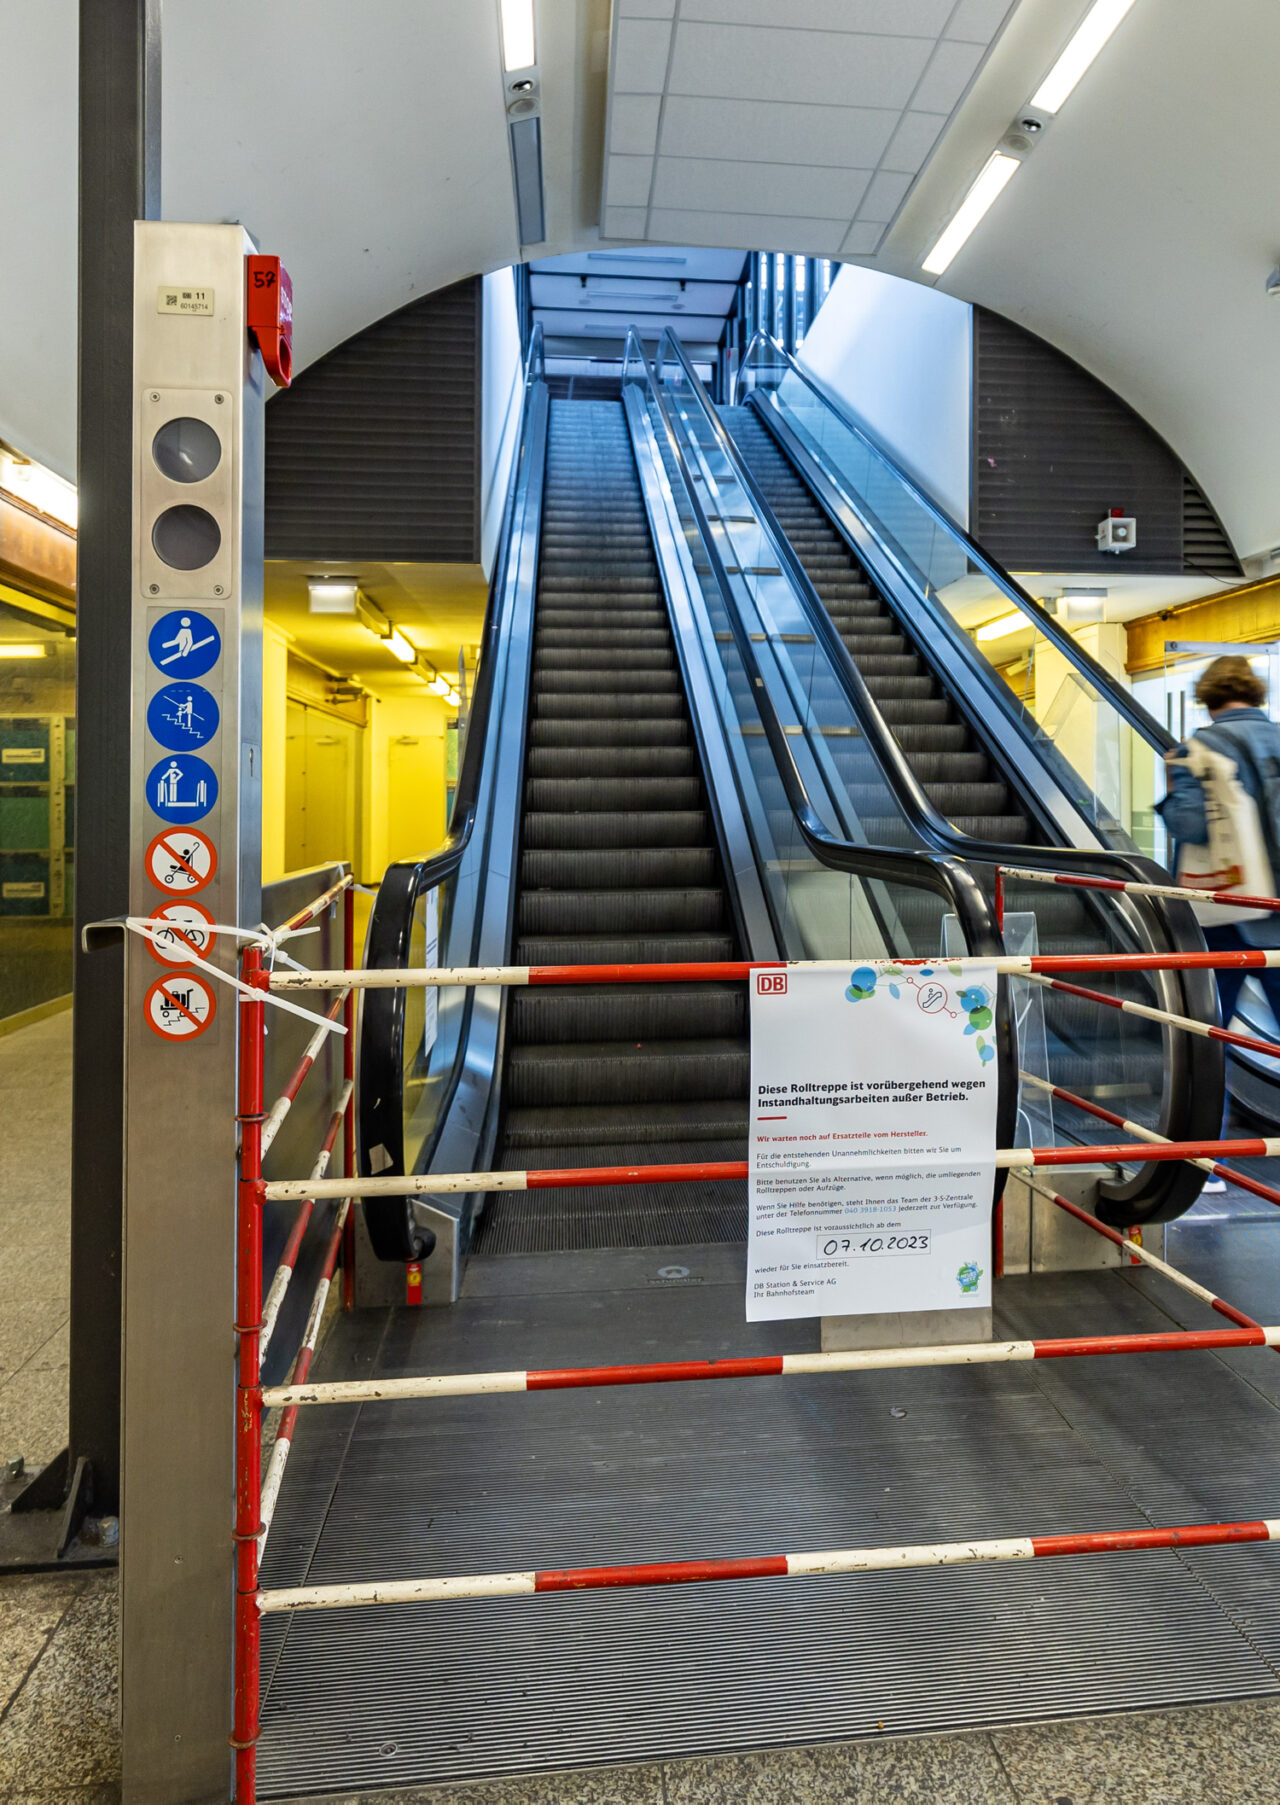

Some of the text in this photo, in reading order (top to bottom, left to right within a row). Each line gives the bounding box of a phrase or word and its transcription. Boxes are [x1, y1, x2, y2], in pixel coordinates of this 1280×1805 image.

[253, 271, 276, 289] 57
[759, 975, 785, 993] DB
[758, 1079, 986, 1095] Diese Rolltreppe ist vorübergehend wegen
[757, 1092, 969, 1108] Instandhaltungsarbeiten außer Betrieb.
[756, 1135, 770, 1143] Wir
[832, 1132, 872, 1140] Ersatzteile
[890, 1130, 929, 1138] Hersteller.
[770, 1152, 782, 1160] die
[782, 1151, 830, 1159] entstehenden
[831, 1147, 902, 1157] Unannehmlichkeiten
[903, 1147, 925, 1155] bitten
[756, 1160, 812, 1169] Entschuldigung.
[756, 1178, 774, 1186] Bitte
[775, 1177, 808, 1185] benutzen
[809, 1176, 820, 1184] Sie
[821, 1176, 832, 1184] als
[833, 1175, 874, 1183] Alternative,
[895, 1172, 925, 1181] möglich,
[925, 1171, 937, 1179] die
[938, 1170, 982, 1179] umliegenden
[756, 1183, 846, 1194] Rolltreppen oder Aufzüge.
[776, 1202, 788, 1210] Sie
[807, 1200, 845, 1208] benötigen,
[846, 1198, 864, 1206] steht
[900, 1196, 919, 1204] Team
[756, 1212, 774, 1220] unter
[789, 1209, 843, 1217] Telefonnummer
[898, 1204, 928, 1213] jederzeit
[942, 1201, 978, 1210] Verfügung.
[756, 1229, 775, 1237] Diese
[776, 1226, 812, 1234] Rolltreppe
[813, 1224, 822, 1232] ist
[823, 1222, 875, 1231] voraussichtlich
[823, 1235, 929, 1256] 07.10.2023
[754, 1266, 778, 1274] wieder
[803, 1261, 849, 1270] einsatzbereit.
[754, 1282, 765, 1290] DB
[766, 1280, 791, 1289] Station
[799, 1279, 825, 1287] Service
[826, 1277, 837, 1285] AG
[766, 1289, 815, 1298] Bahnhofsteam
